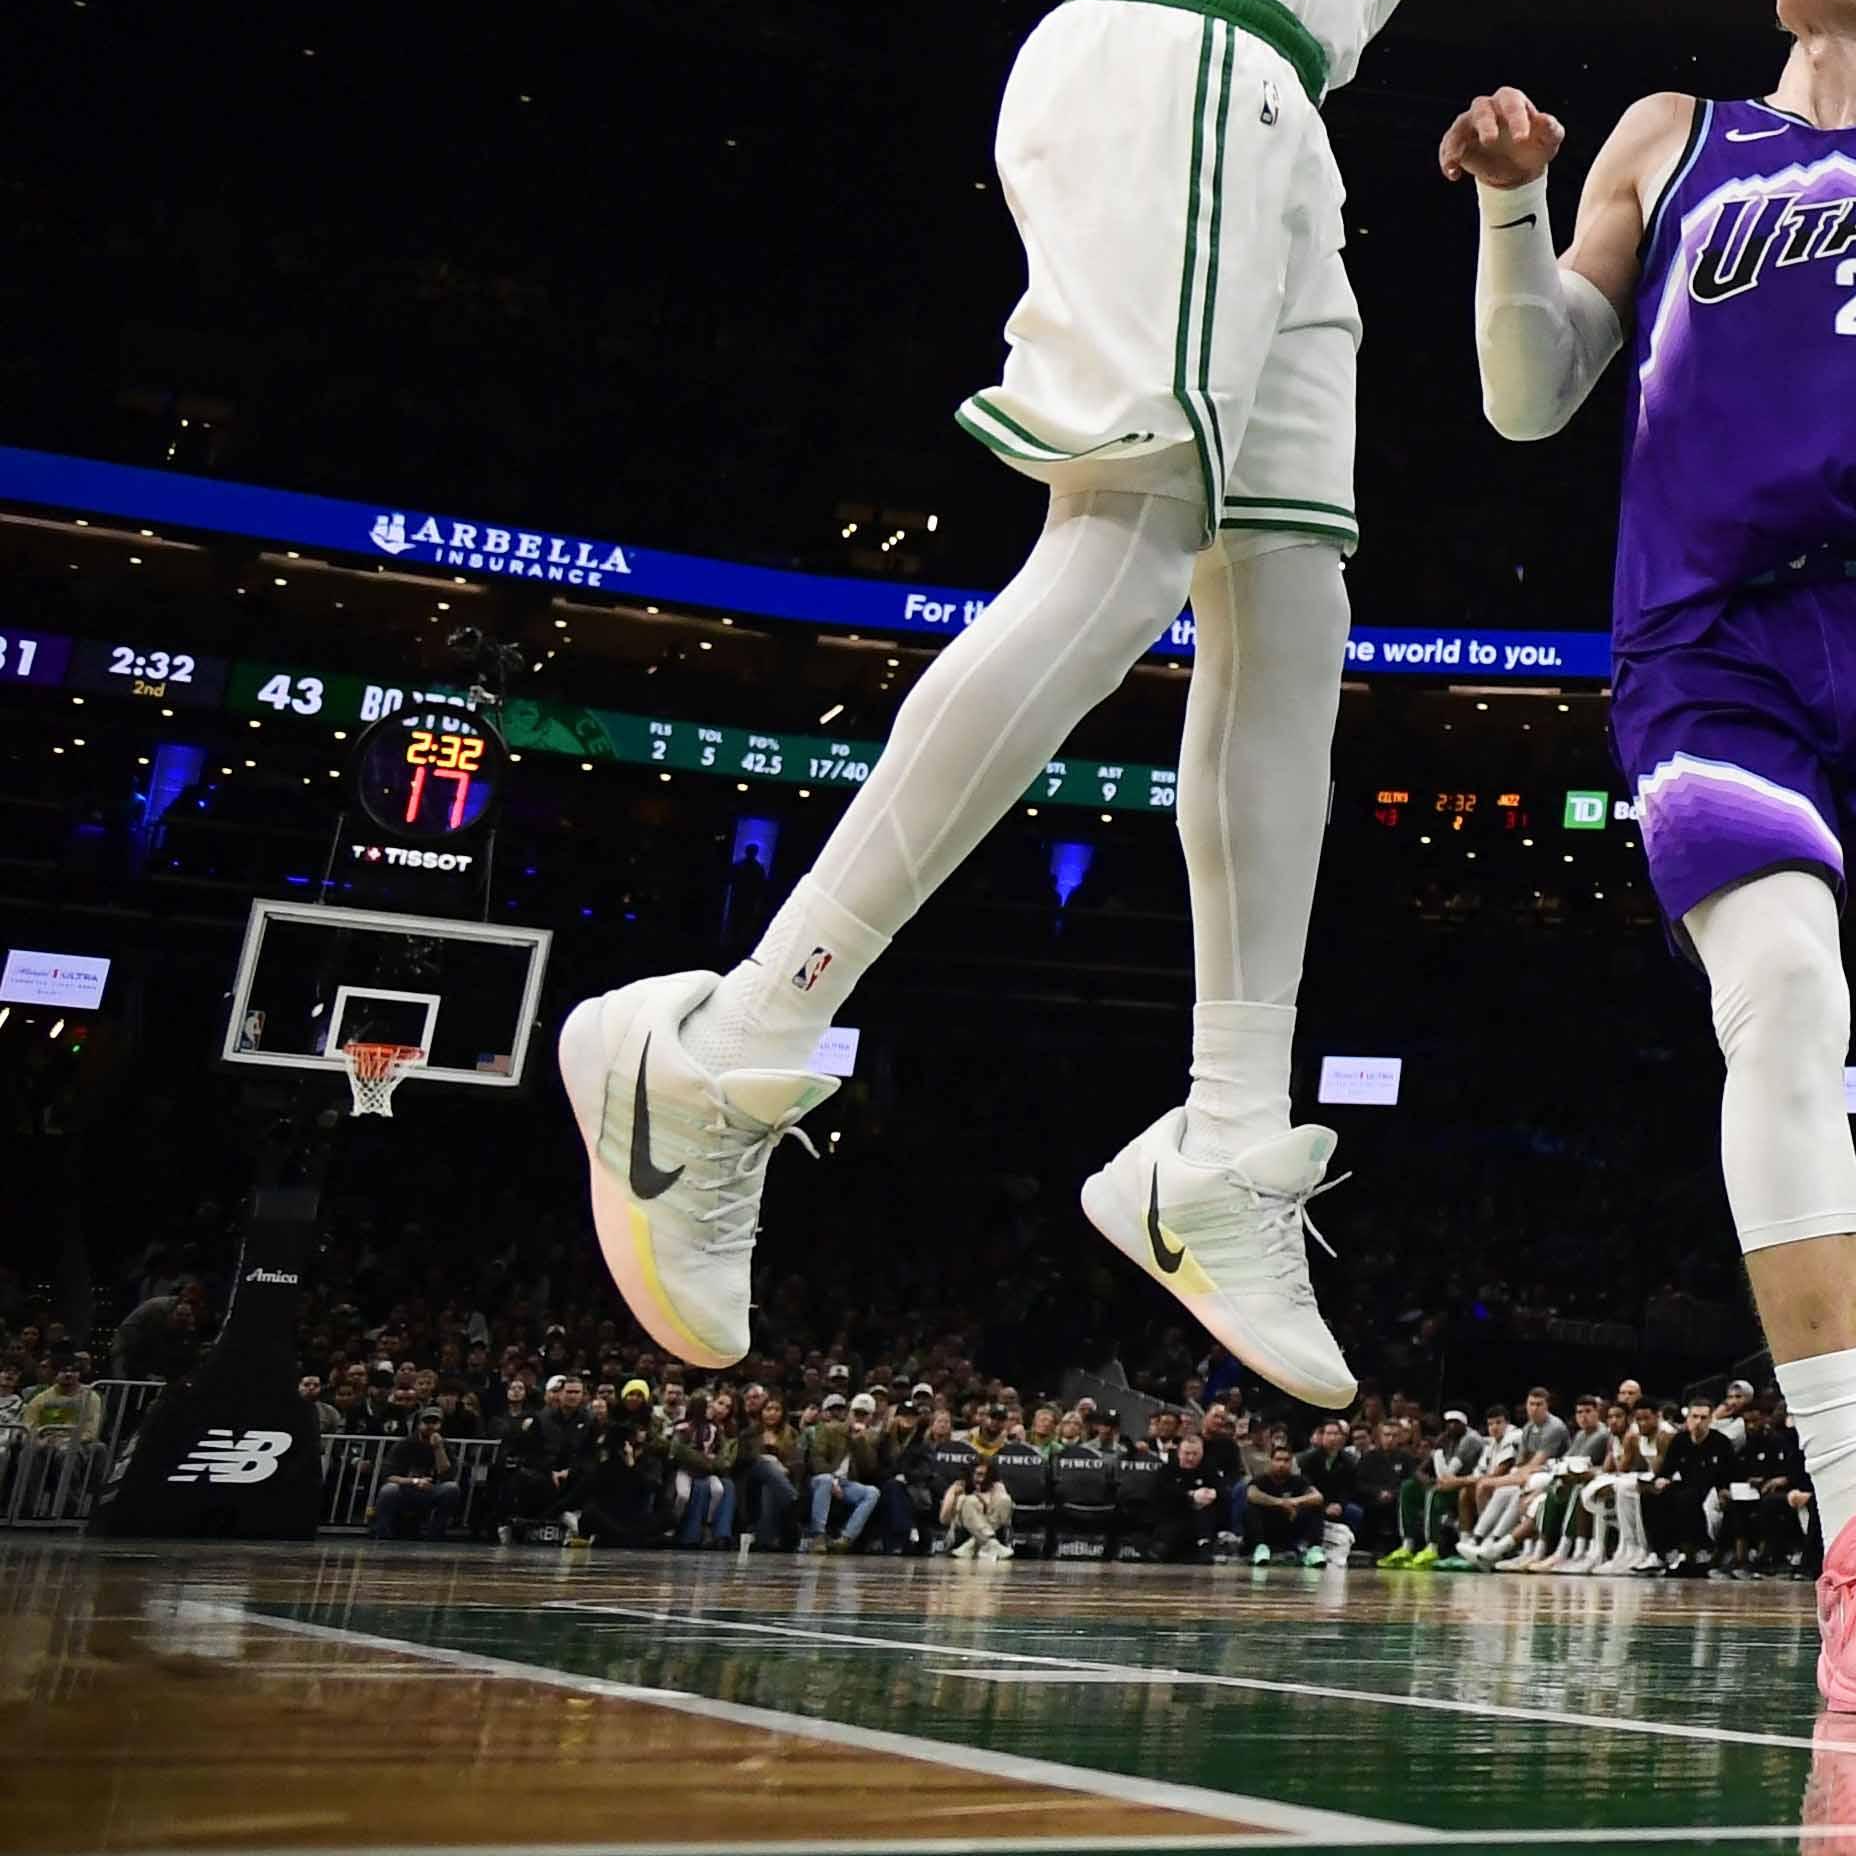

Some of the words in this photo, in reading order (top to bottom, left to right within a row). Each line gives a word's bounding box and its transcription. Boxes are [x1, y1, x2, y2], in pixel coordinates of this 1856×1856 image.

[411, 516, 632, 574] ARBELLA
[435, 547, 602, 587] INSURANCE
[905, 594, 957, 625] For
[108, 646, 195, 682] 2:32
[1382, 635, 1462, 664] world
[1469, 639, 1497, 664] to
[1503, 642, 1563, 671] you.
[133, 680, 166, 698] 2nd
[257, 674, 325, 715] 43
[406, 730, 485, 772] 2:32
[652, 740, 667, 760] 2
[700, 746, 716, 766] 5
[741, 752, 783, 775] 42.5
[809, 758, 869, 782] 17/40
[1098, 766, 1124, 781] AST
[406, 765, 471, 830] 17
[1046, 778, 1060, 798] 7
[1102, 783, 1117, 803] 9
[1149, 785, 1175, 807] 20
[1436, 792, 1477, 813] 2:32
[1568, 796, 1603, 823] TD
[384, 846, 472, 873] TISSOT
[246, 1268, 298, 1285] Amica
[998, 1454, 1043, 1467] PIMCO
[1060, 1457, 1104, 1471] PIMCO
